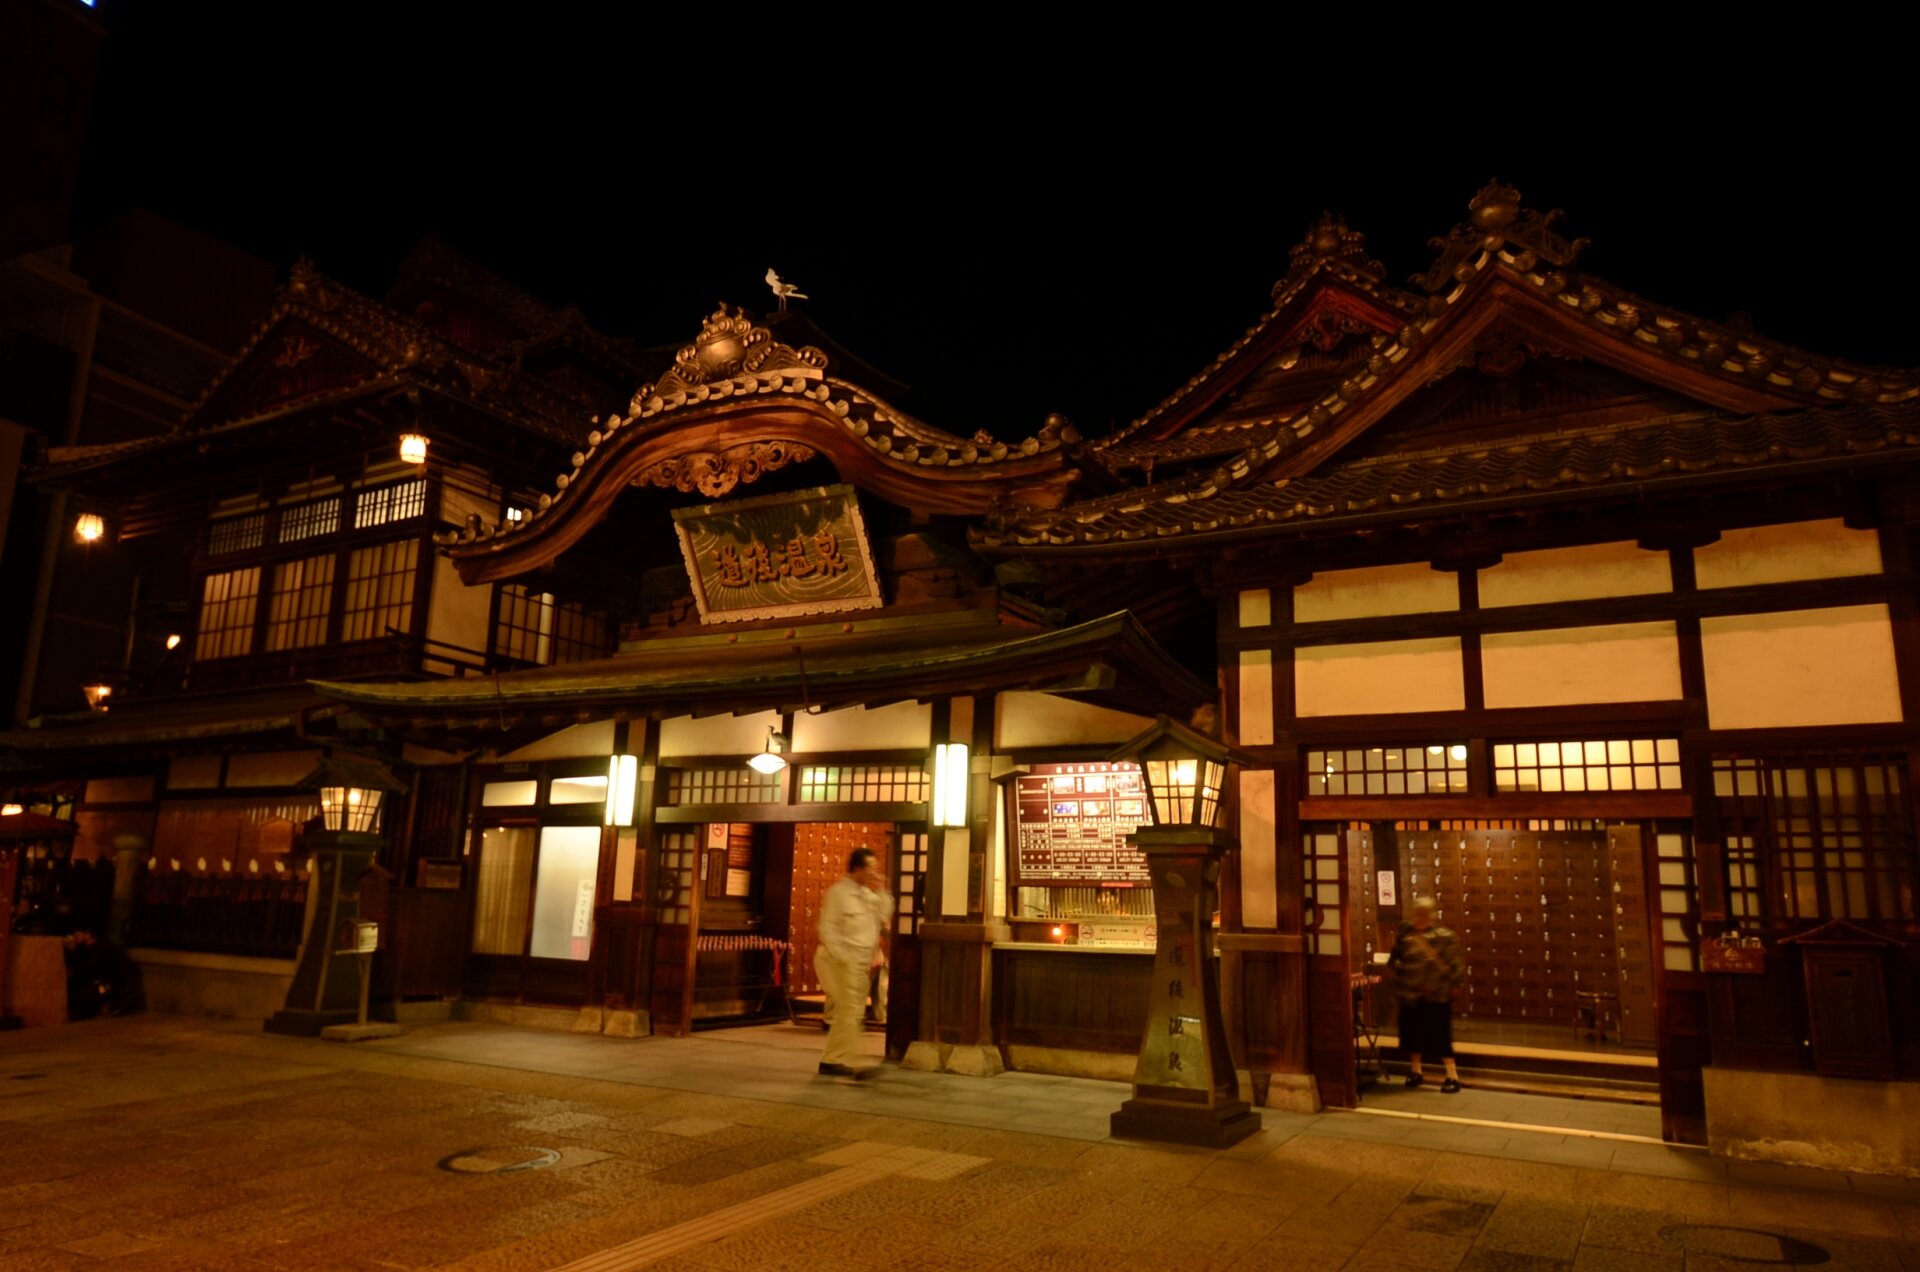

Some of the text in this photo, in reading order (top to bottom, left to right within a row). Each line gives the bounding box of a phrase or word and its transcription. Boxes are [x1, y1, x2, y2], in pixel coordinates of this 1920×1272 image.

[711, 530, 849, 588] 道後温泉
[1168, 945, 1186, 1072] 道後温泉
